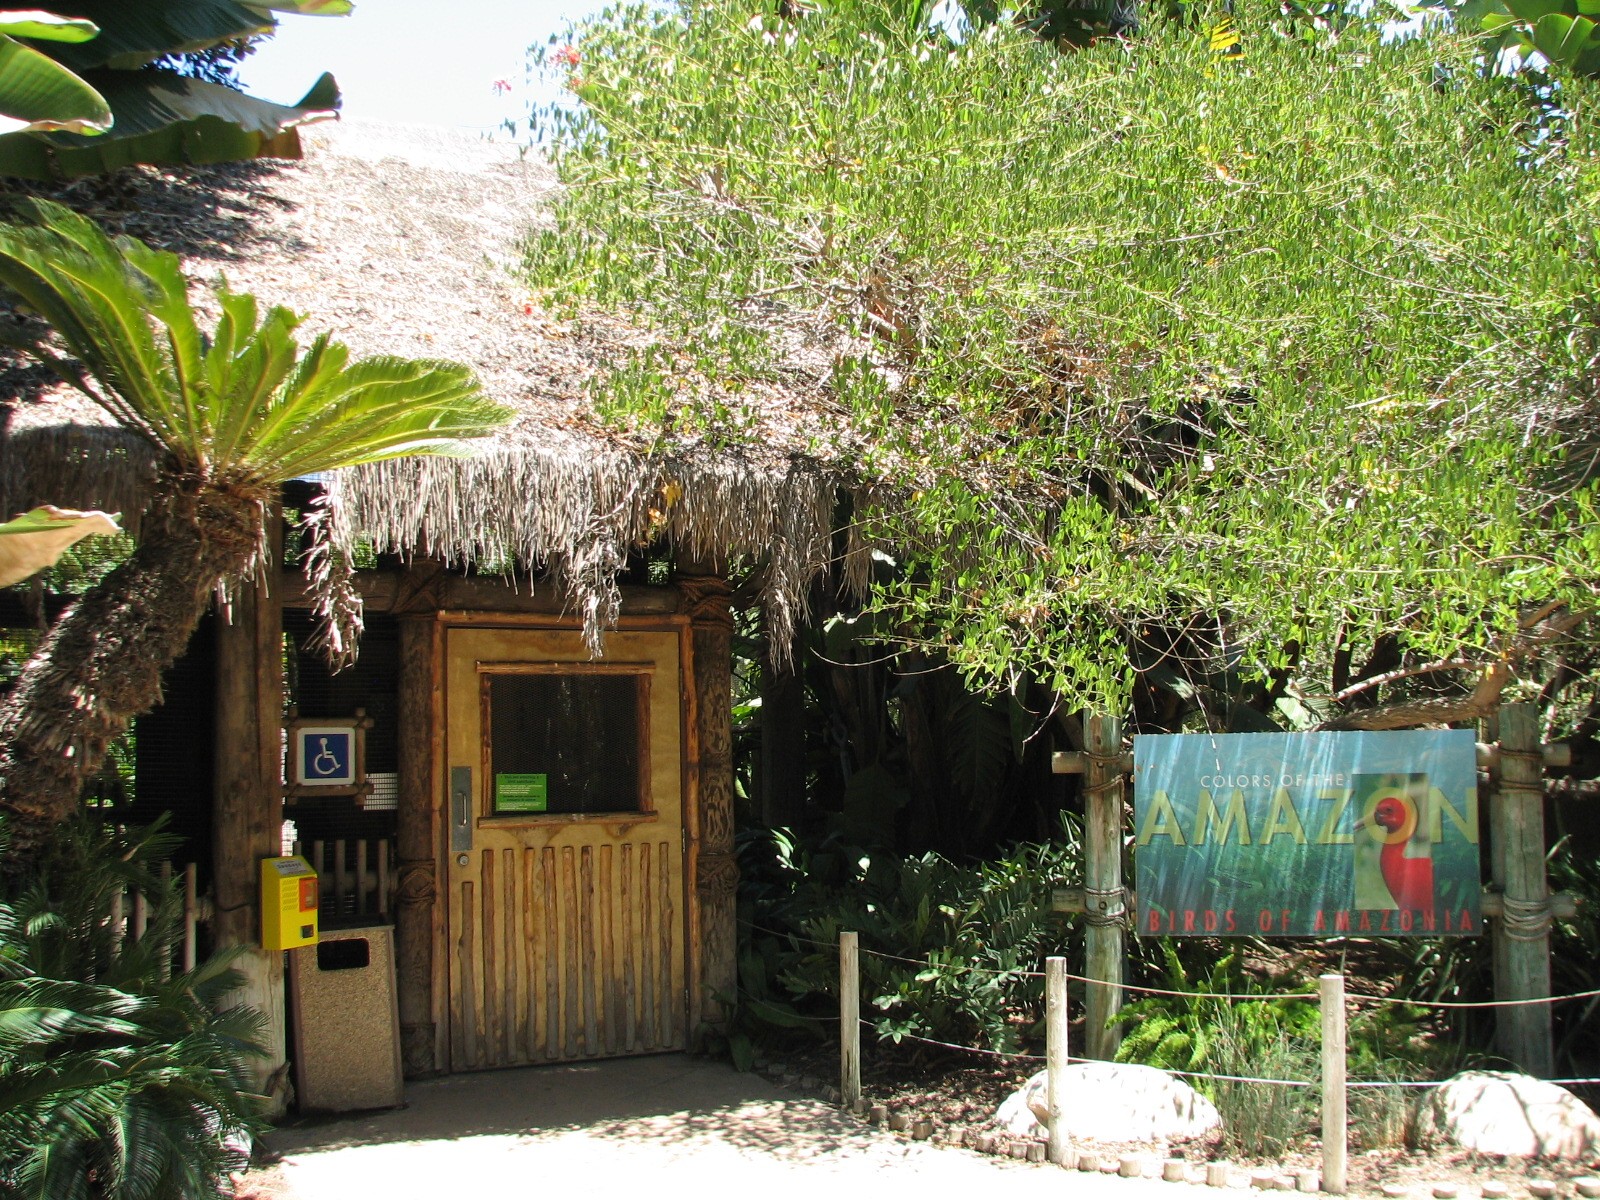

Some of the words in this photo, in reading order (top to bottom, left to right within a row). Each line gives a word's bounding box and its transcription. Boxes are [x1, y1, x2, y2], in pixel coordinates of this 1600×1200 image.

[1200, 774, 1271, 789] COLORS
[1280, 774, 1304, 788] OF
[1311, 773, 1344, 787] THE
[1136, 786, 1479, 846] AMAZON
[1149, 908, 1237, 932] BIRDS
[1259, 908, 1290, 931] OF
[1313, 908, 1474, 931] AMAZONIA
